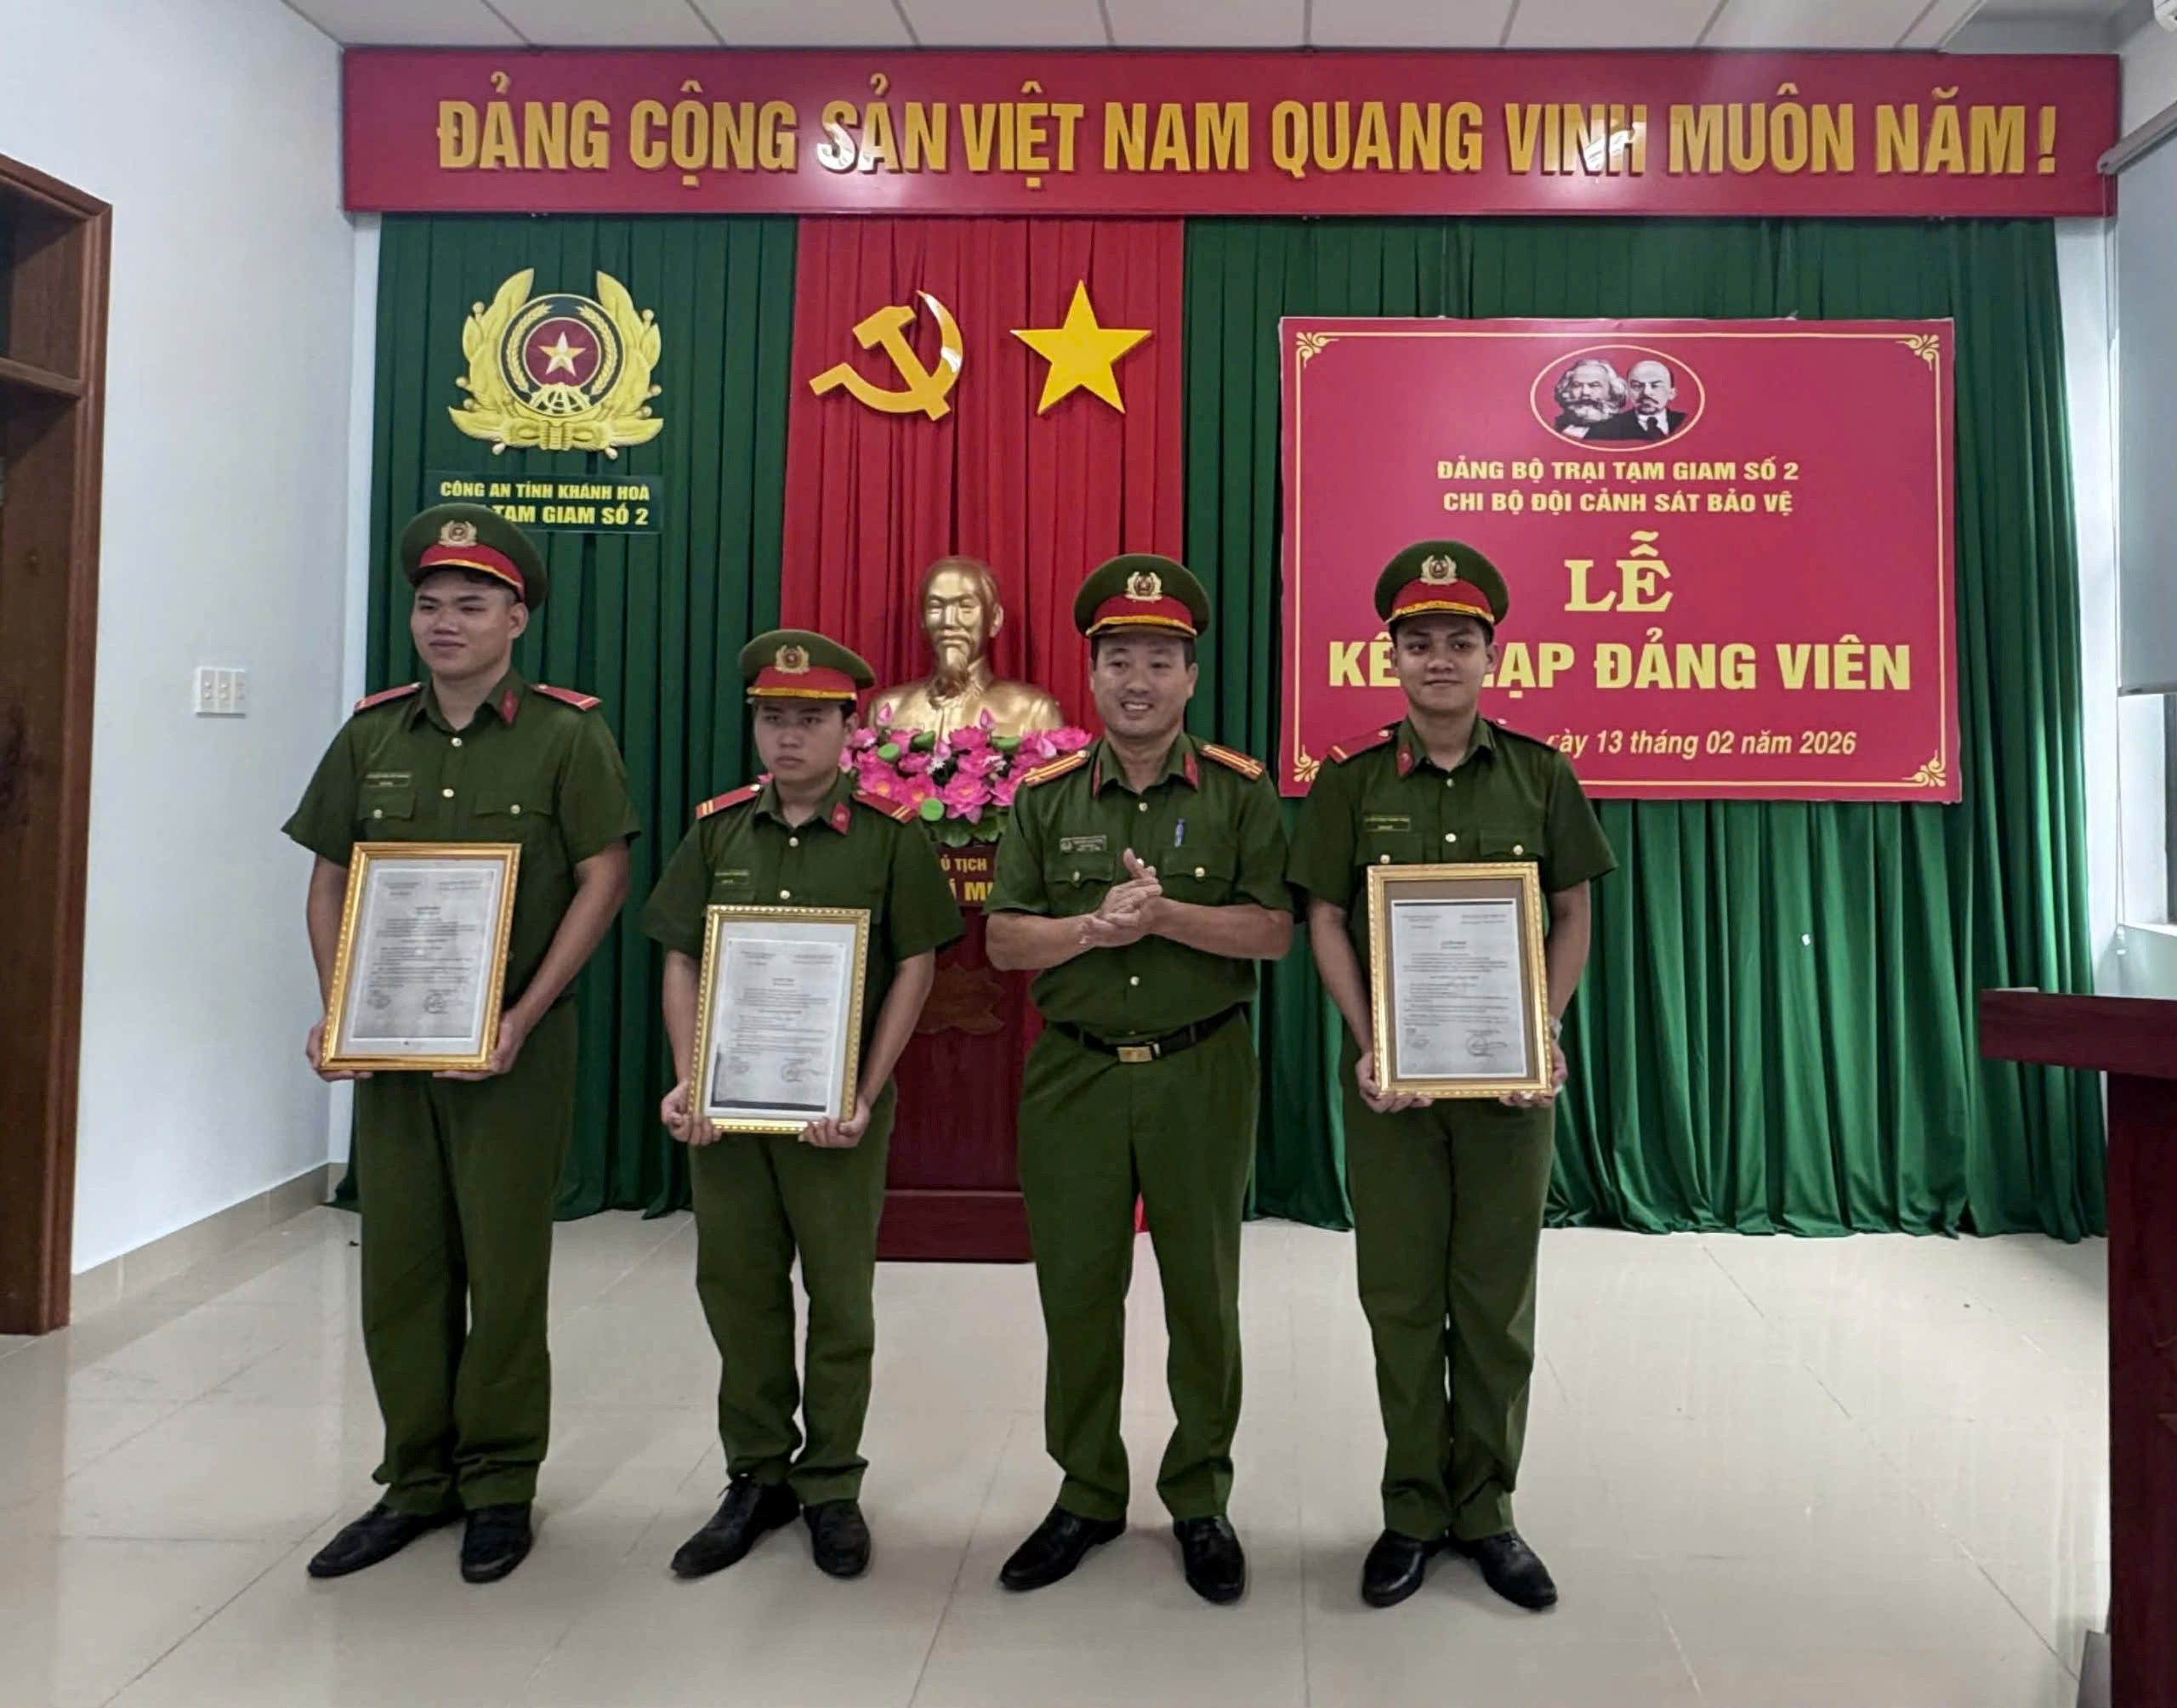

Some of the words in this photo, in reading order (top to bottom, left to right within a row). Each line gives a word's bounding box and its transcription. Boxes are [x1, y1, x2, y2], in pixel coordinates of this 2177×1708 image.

[437, 72, 609, 171] ĐẢNG
[630, 80, 798, 188] CỘNG
[817, 73, 950, 173] SẢN
[961, 81, 1084, 188] VIỆT
[1103, 101, 1249, 173] NAM
[1270, 100, 1483, 180] QUANG
[1506, 102, 1648, 176] VINH
[1668, 82, 1855, 174] MUÔN
[1875, 85, 2026, 175] NĂM
[2038, 105, 2057, 174] !
[1437, 455, 1504, 480] ĐẢNG
[1511, 457, 1544, 484] BỘ
[1551, 462, 1606, 484] TRẠI
[1614, 462, 1665, 484] TẠM
[1672, 461, 1736, 480] GIAM
[1743, 457, 1776, 480] SỐ
[1782, 462, 1799, 480] 2
[441, 480, 486, 497] CÔNG
[489, 483, 511, 498] AN
[558, 482, 612, 500] KHÁNH
[1443, 492, 1484, 512] CHI
[1491, 490, 1524, 515] BỘ
[1531, 490, 1572, 515] ĐỘI
[1579, 488, 1647, 513] CẢNH
[1654, 489, 1700, 513] SÁT
[1707, 489, 1756, 513] BẢO
[1763, 491, 1793, 516] VỆ
[542, 505, 595, 525] GIAM
[601, 502, 629, 525] SỐ
[634, 508, 649, 525] 2
[1564, 531, 1673, 612] LỄ
[1481, 642, 1575, 698] ẠP
[1593, 627, 1757, 690] ĐẢNG
[1776, 634, 1912, 691] VIÊN
[1596, 730, 1623, 753] 13
[1629, 729, 1699, 759] tháng
[1705, 732, 1733, 753] 02
[1740, 730, 1792, 754] năm
[1798, 732, 1856, 754] 2026
